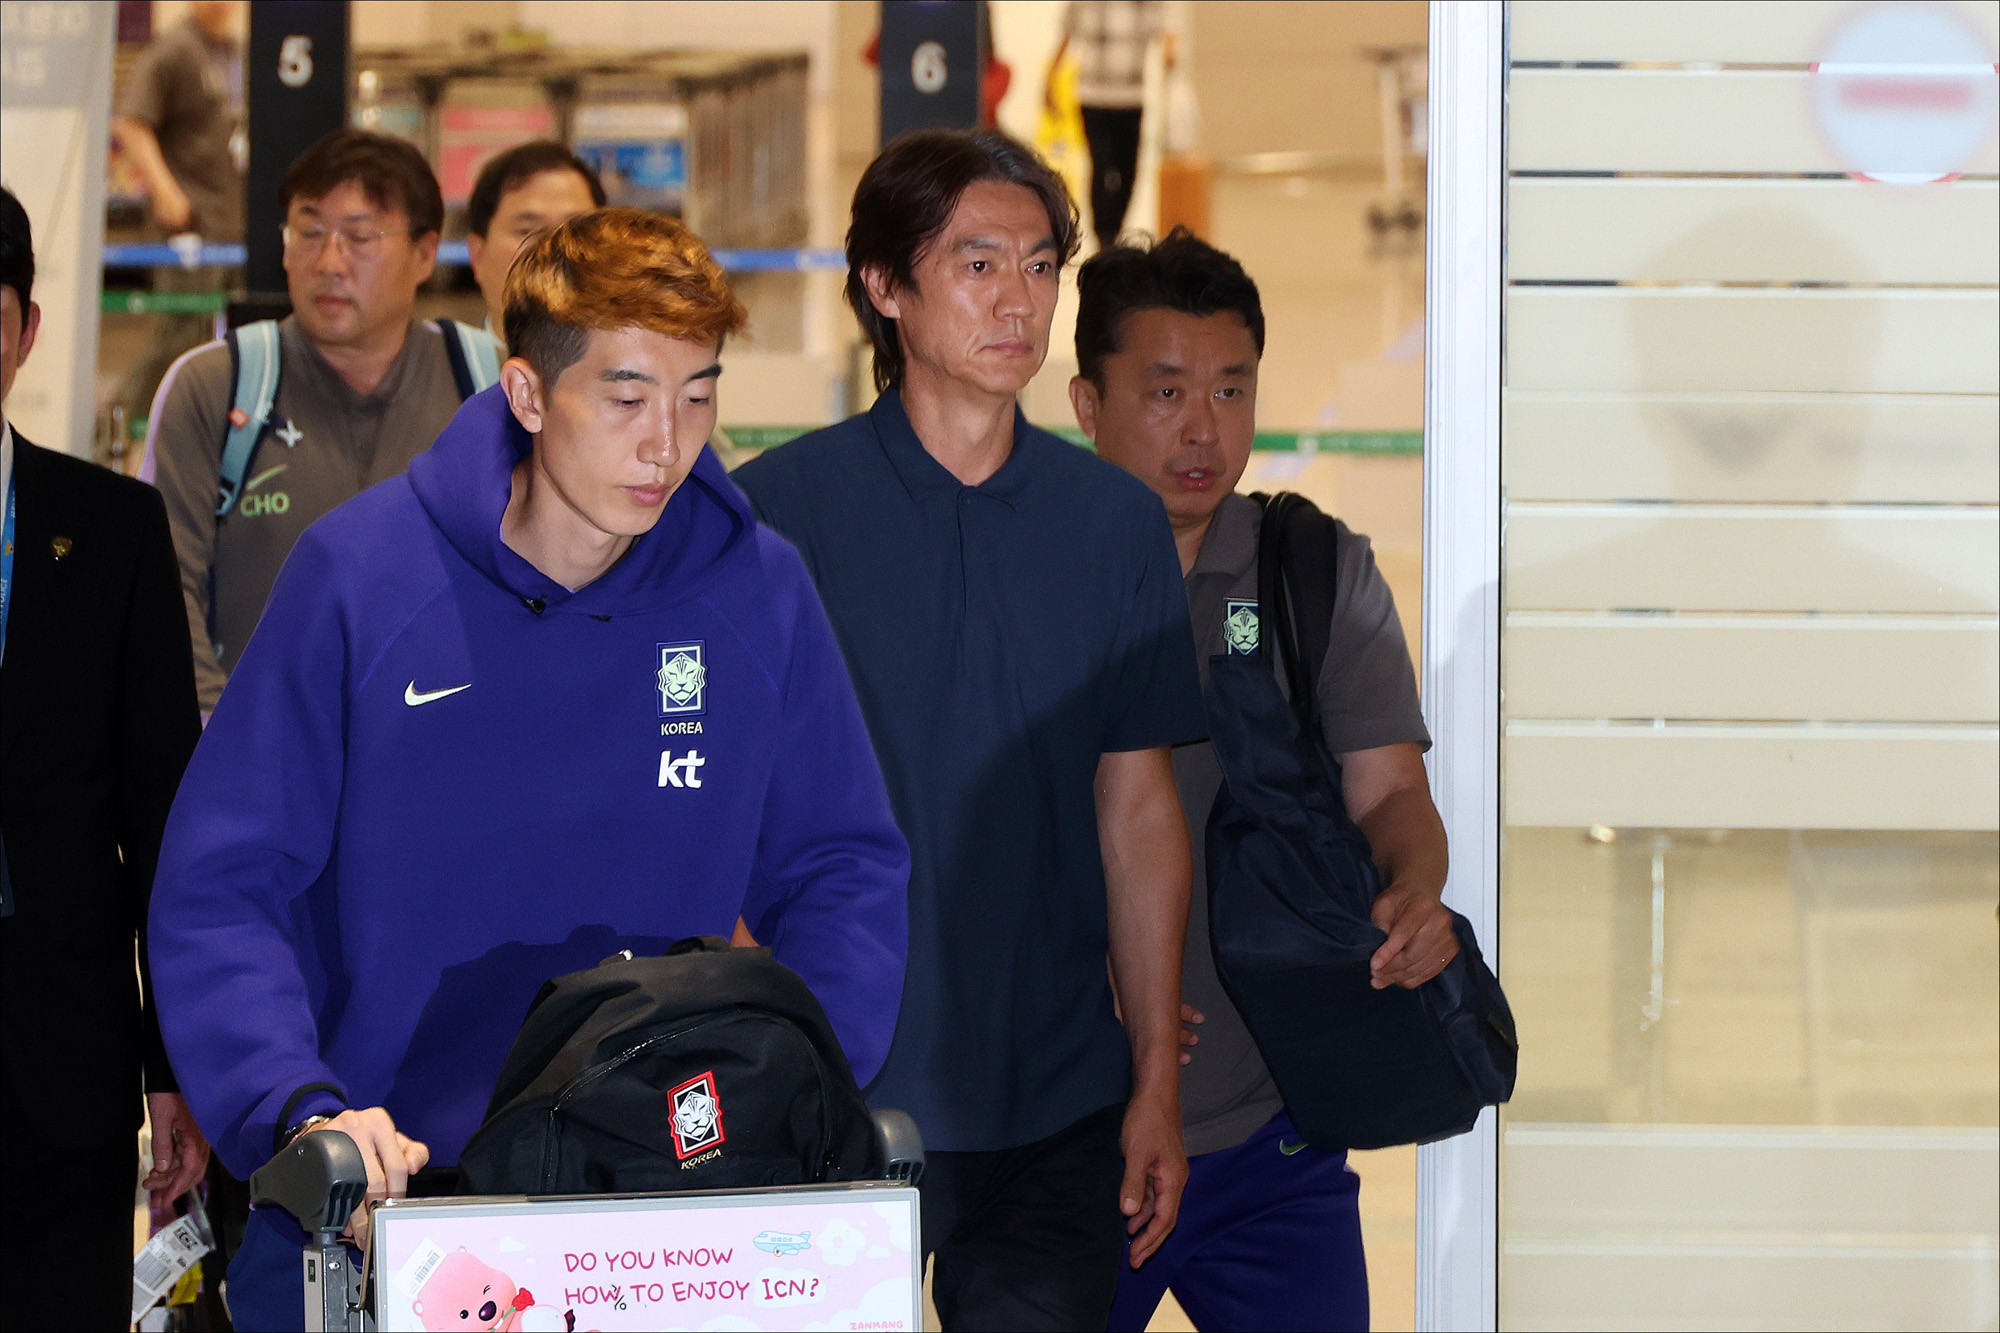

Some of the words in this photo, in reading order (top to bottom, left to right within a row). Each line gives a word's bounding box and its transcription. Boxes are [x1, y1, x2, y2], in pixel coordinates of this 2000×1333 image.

[278, 35, 313, 87] 5
[911, 41, 948, 95] 6
[240, 492, 290, 516] CHO
[661, 721, 703, 736] KOREA
[658, 749, 706, 789] kt
[681, 1148, 721, 1169] KOREA
[564, 1252, 597, 1272] DO
[605, 1250, 655, 1272] YOU
[663, 1247, 733, 1268] KNOW
[565, 1284, 622, 1306] HOW
[630, 1283, 664, 1302] TO
[672, 1279, 750, 1302] ENJOY
[761, 1277, 819, 1300] ICN?
[850, 1320, 904, 1331] ZANMANG
